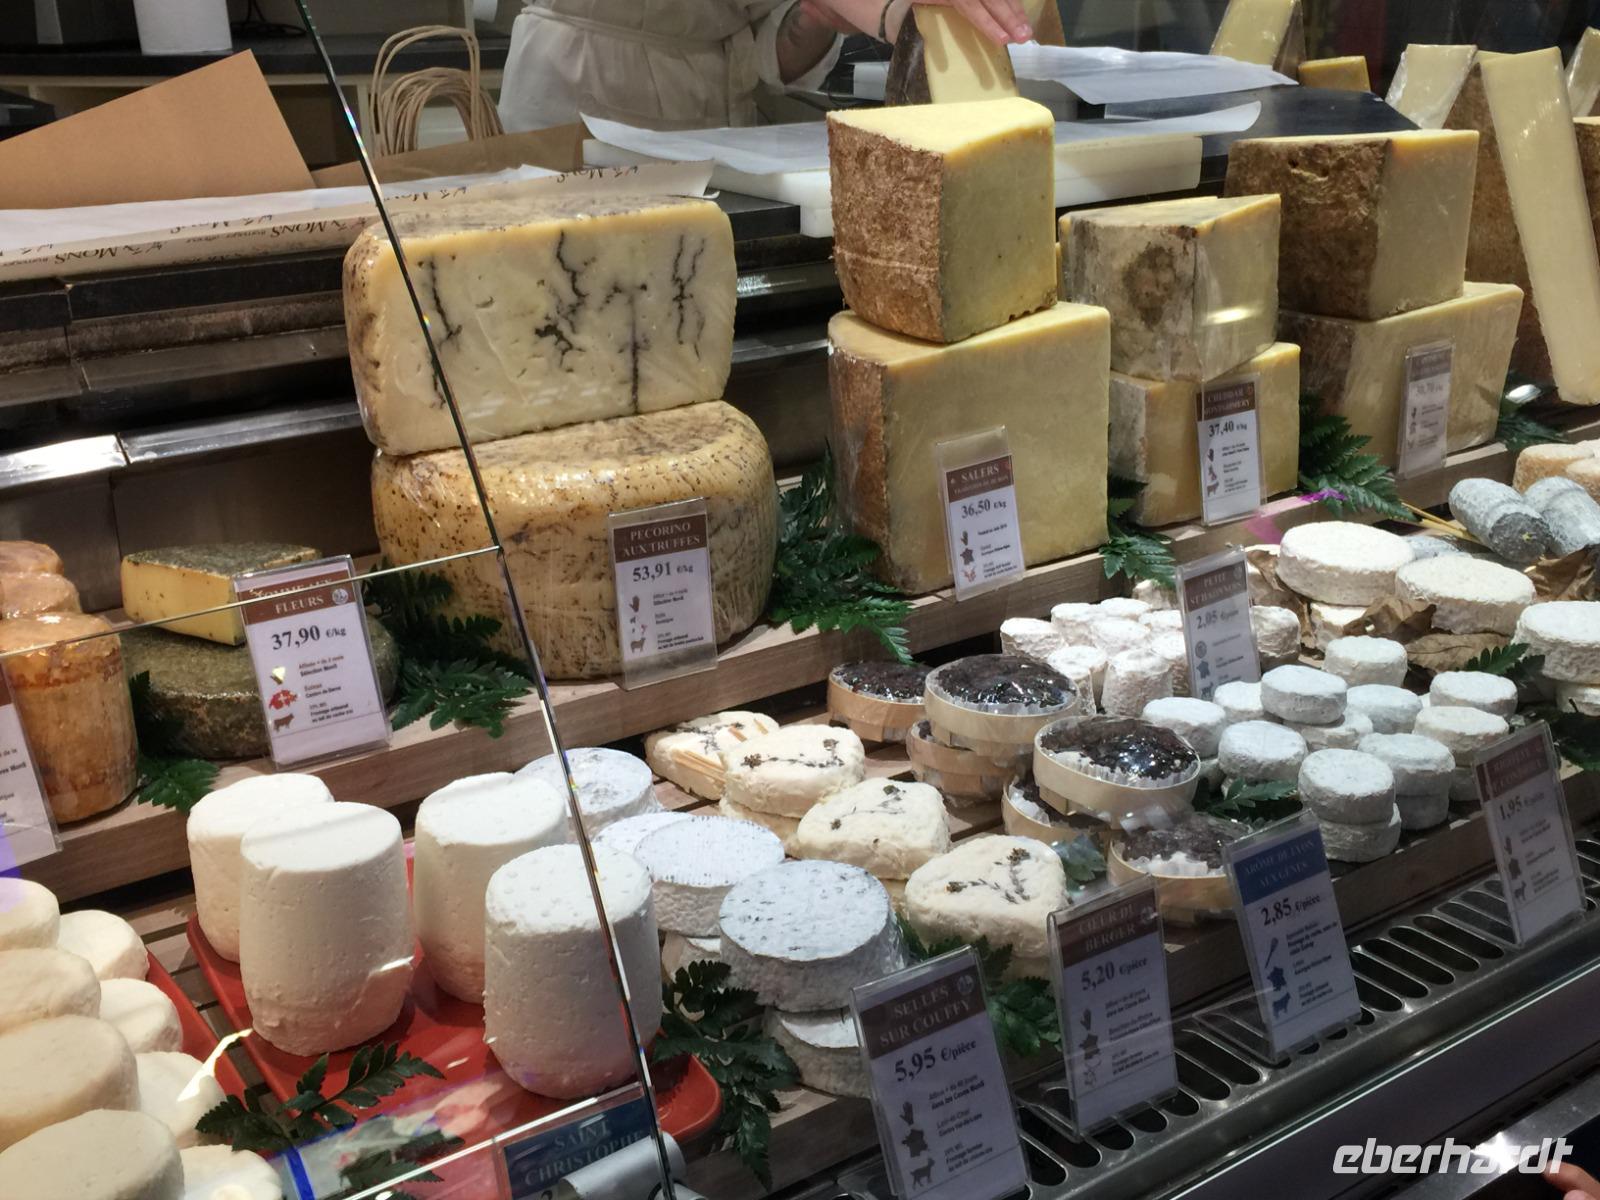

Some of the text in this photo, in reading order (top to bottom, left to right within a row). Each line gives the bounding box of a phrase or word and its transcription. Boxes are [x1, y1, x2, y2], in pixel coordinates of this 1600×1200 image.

[55, 247, 118, 264] MONS
[1208, 421, 1235, 438] 37,40
[961, 463, 999, 484] SALERS
[961, 498, 991, 519] 36,50
[630, 521, 691, 542] PECORINO
[650, 535, 701, 553] TRUFFES
[632, 561, 672, 582] 53,91
[274, 595, 325, 614] FLEURS
[1196, 610, 1218, 630] 2,05
[271, 625, 347, 651] 37,90 €/kg
[1499, 796, 1522, 821] 1,95
[1260, 898, 1294, 926] 2,85
[1081, 961, 1116, 991] 5,20
[893, 984, 950, 1019] SELLES
[879, 998, 974, 1048] SUR COUFFY
[894, 1037, 977, 1082] 5,95 €/pièce
[553, 1118, 613, 1150] SAINT
